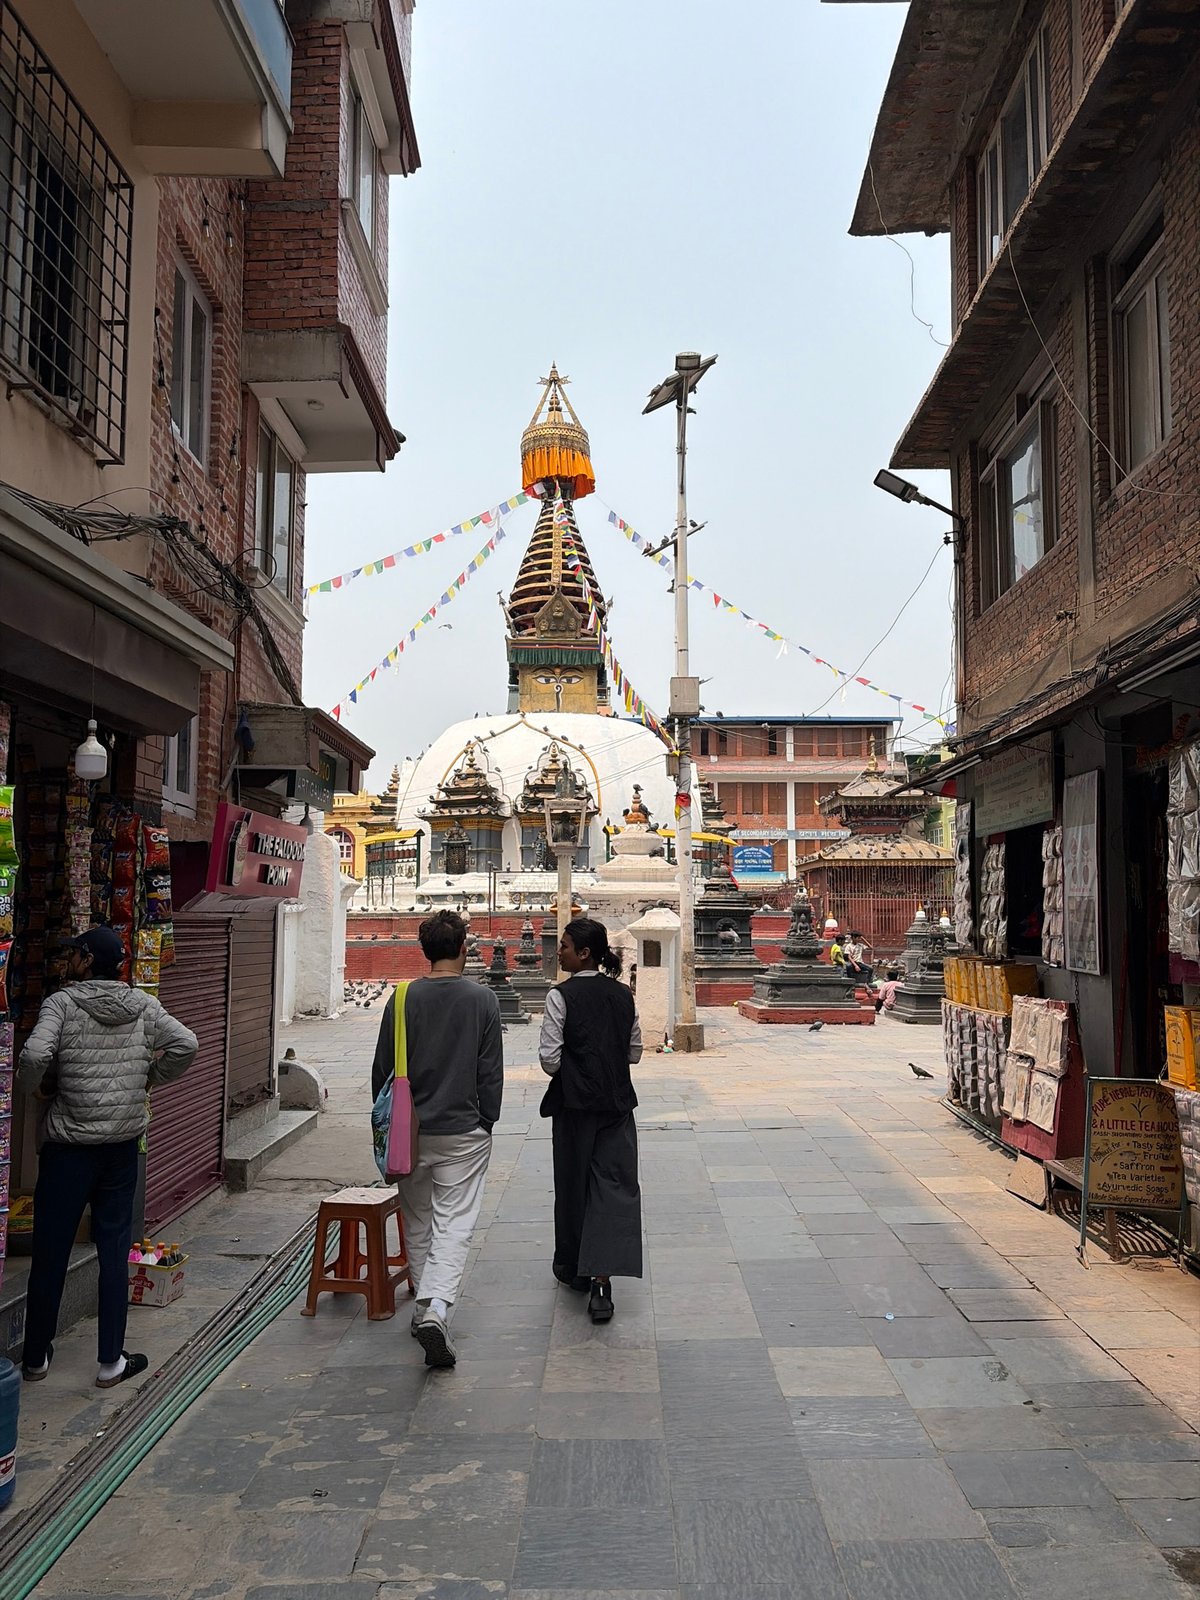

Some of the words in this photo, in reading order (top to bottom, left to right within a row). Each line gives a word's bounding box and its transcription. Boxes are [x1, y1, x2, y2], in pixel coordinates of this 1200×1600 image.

[257, 833, 273, 856] THE
[266, 863, 292, 886] POINT
[1092, 1119, 1098, 1129] &
[1100, 1120, 1105, 1129] A
[1107, 1120, 1136, 1131] LITTLE
[1132, 1140, 1153, 1151] Tasty
[1119, 1161, 1155, 1171] Saffron
[1112, 1171, 1127, 1180] Tea
[1130, 1174, 1166, 1182] Varieties
[1102, 1181, 1143, 1192] Ayurvedic
[1146, 1184, 1169, 1194] Soaps
